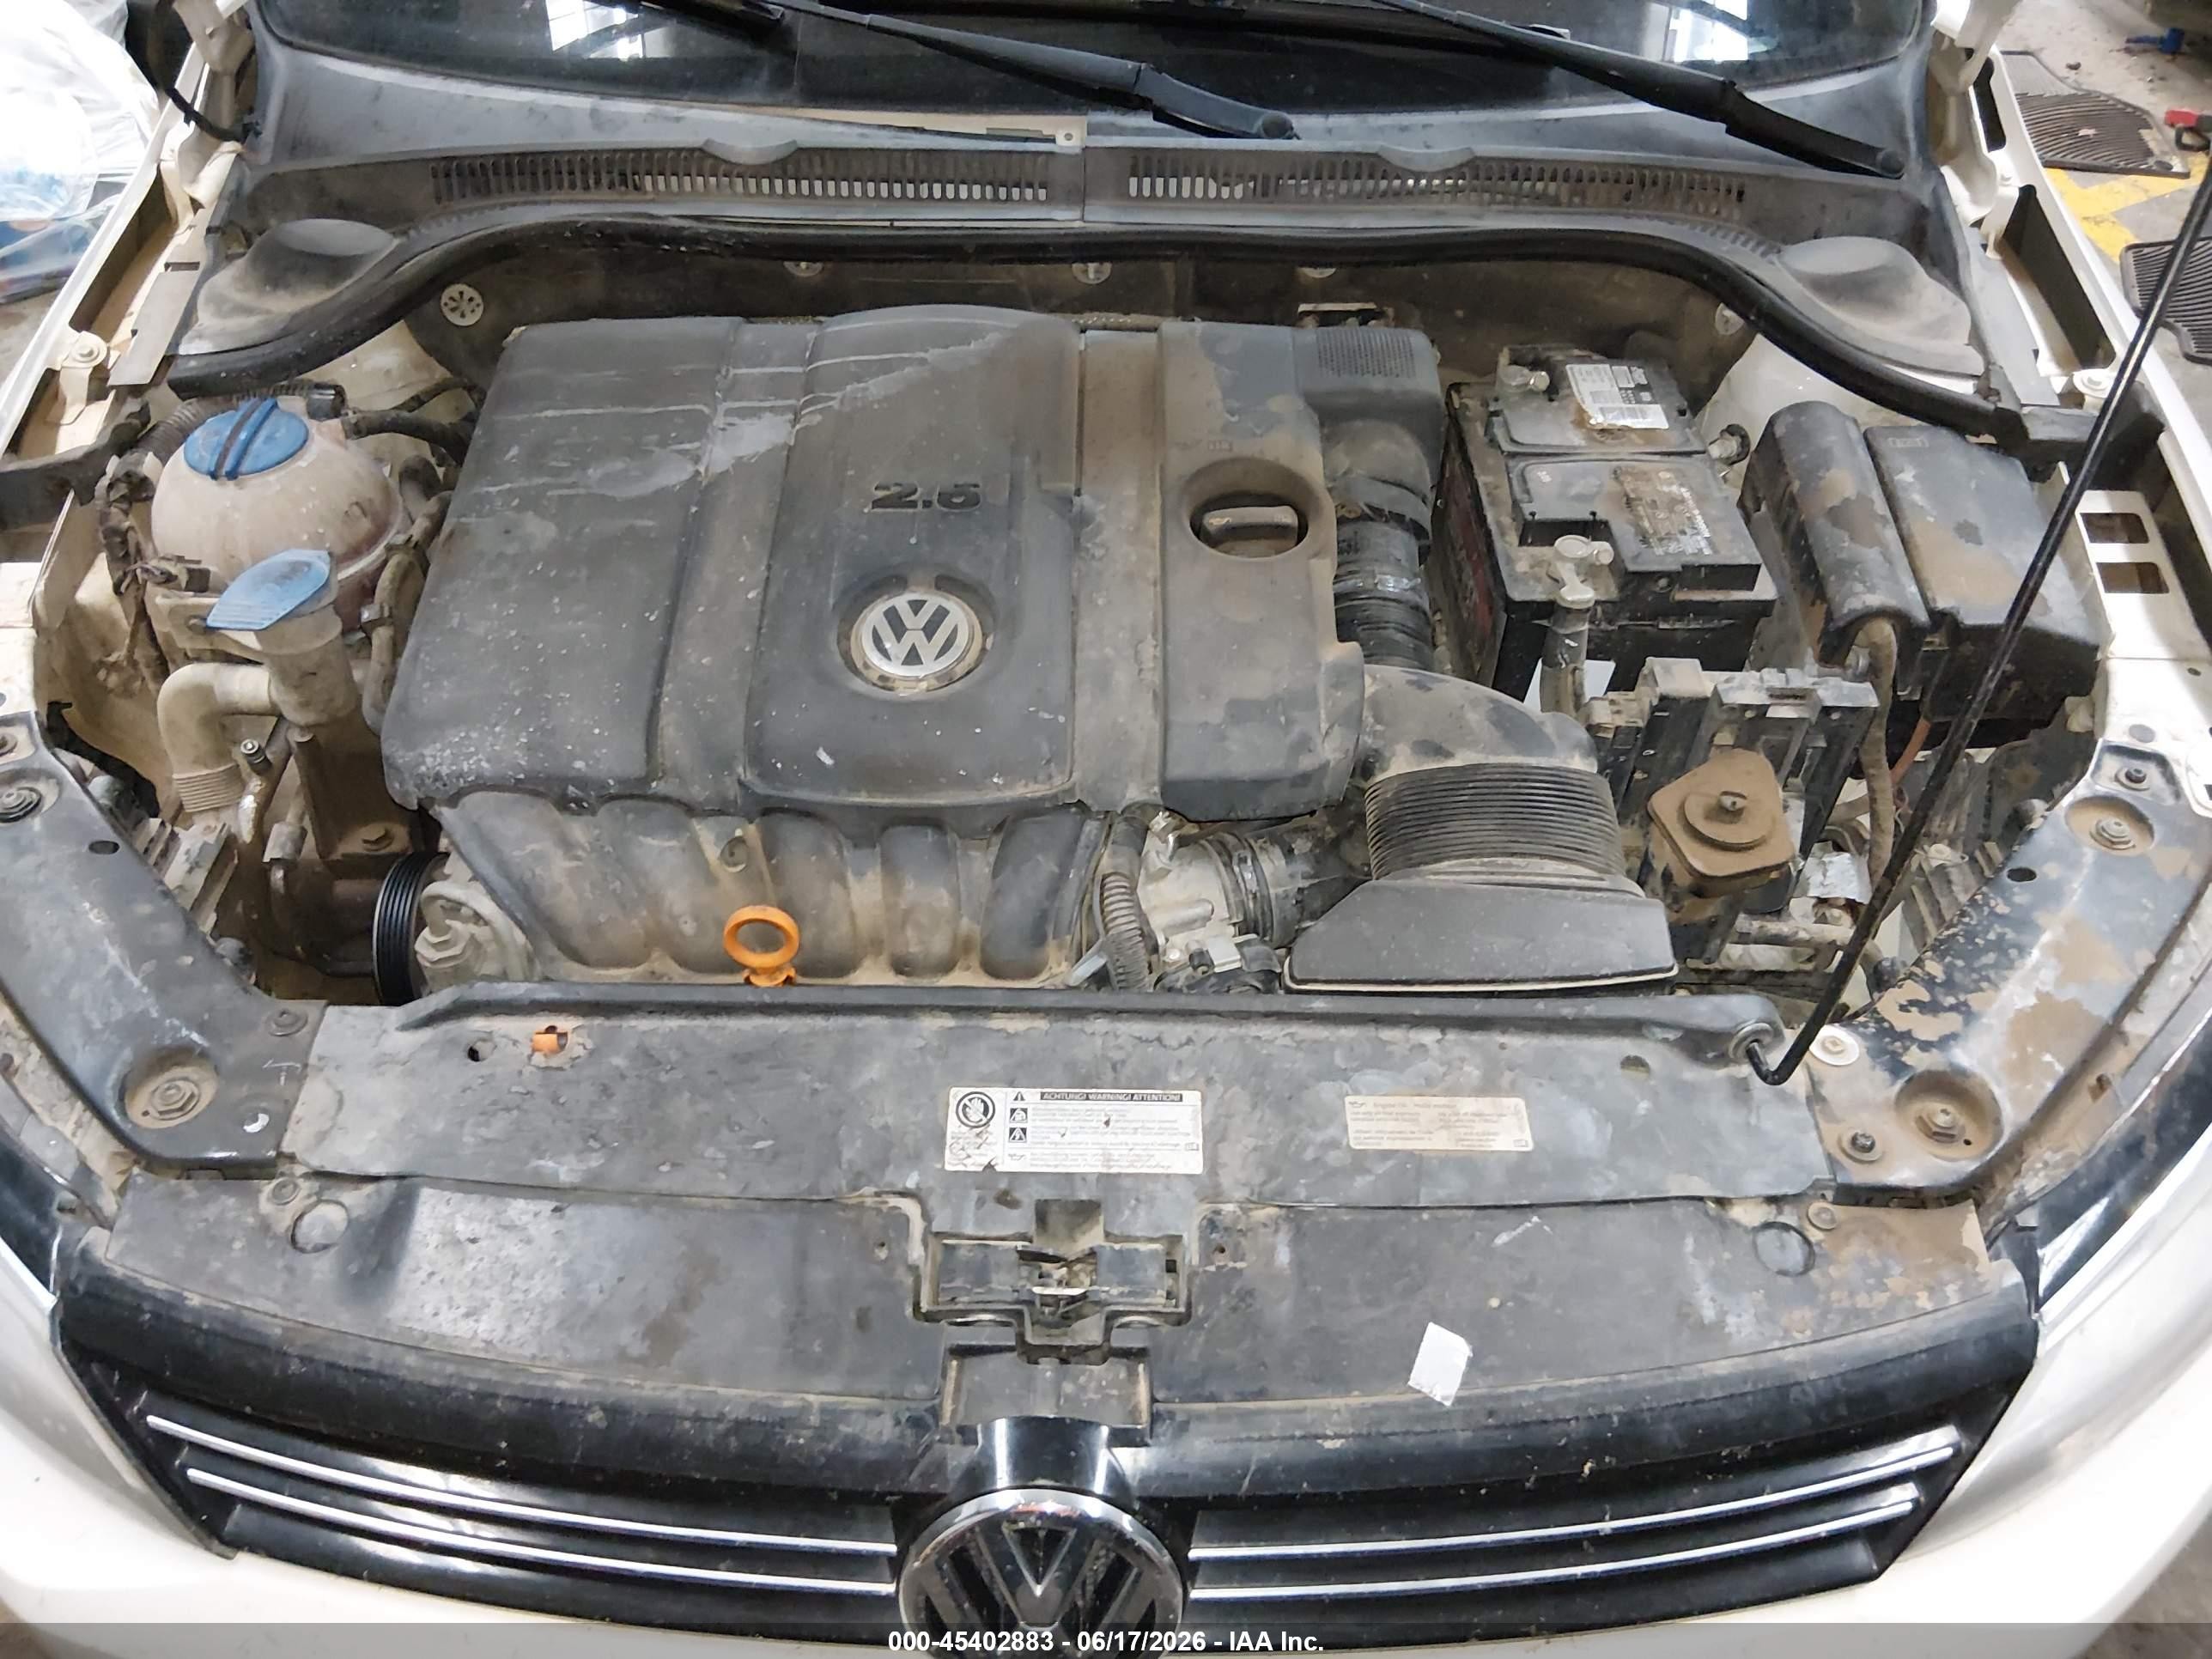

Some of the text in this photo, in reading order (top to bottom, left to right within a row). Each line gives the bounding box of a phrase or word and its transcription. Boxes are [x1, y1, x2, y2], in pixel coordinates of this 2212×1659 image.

[871, 481, 981, 510] 2.5
[870, 598, 961, 669] VW
[1042, 1092, 1181, 1102] ACHTUNG! WARNING! ATTENTION!
